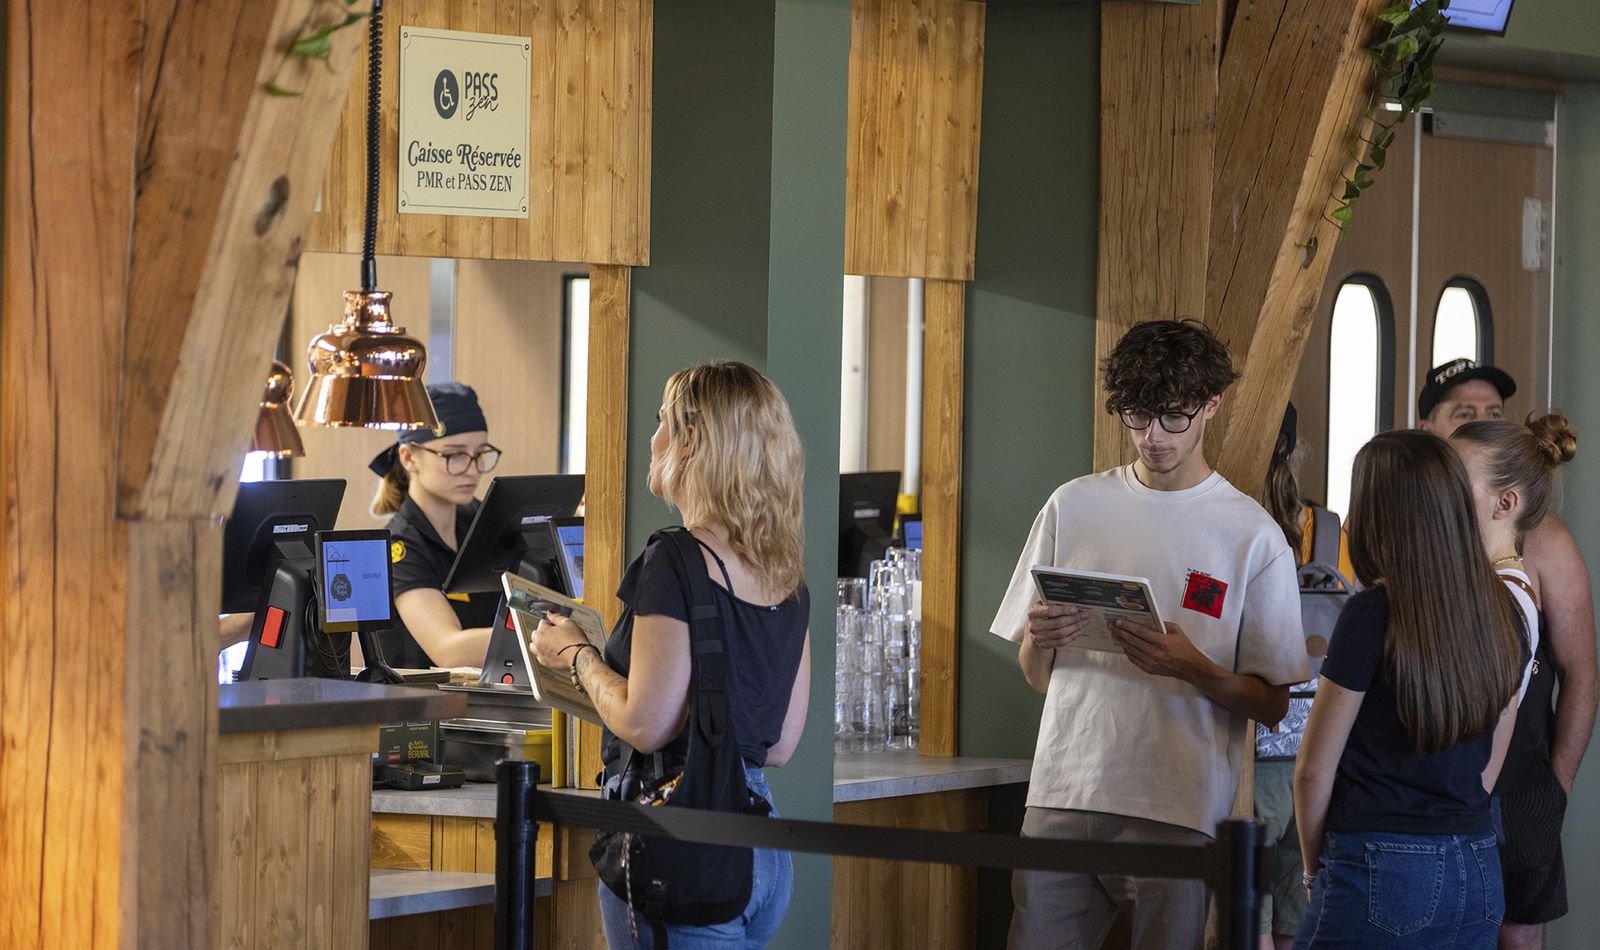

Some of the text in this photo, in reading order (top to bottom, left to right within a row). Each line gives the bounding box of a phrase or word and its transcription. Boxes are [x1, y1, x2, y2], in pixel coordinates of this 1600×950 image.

[465, 71, 498, 101] PASS
[466, 97, 499, 121] zen
[408, 140, 522, 172] Caisse Réservée
[417, 171, 513, 192] PMR et PASS ZEN
